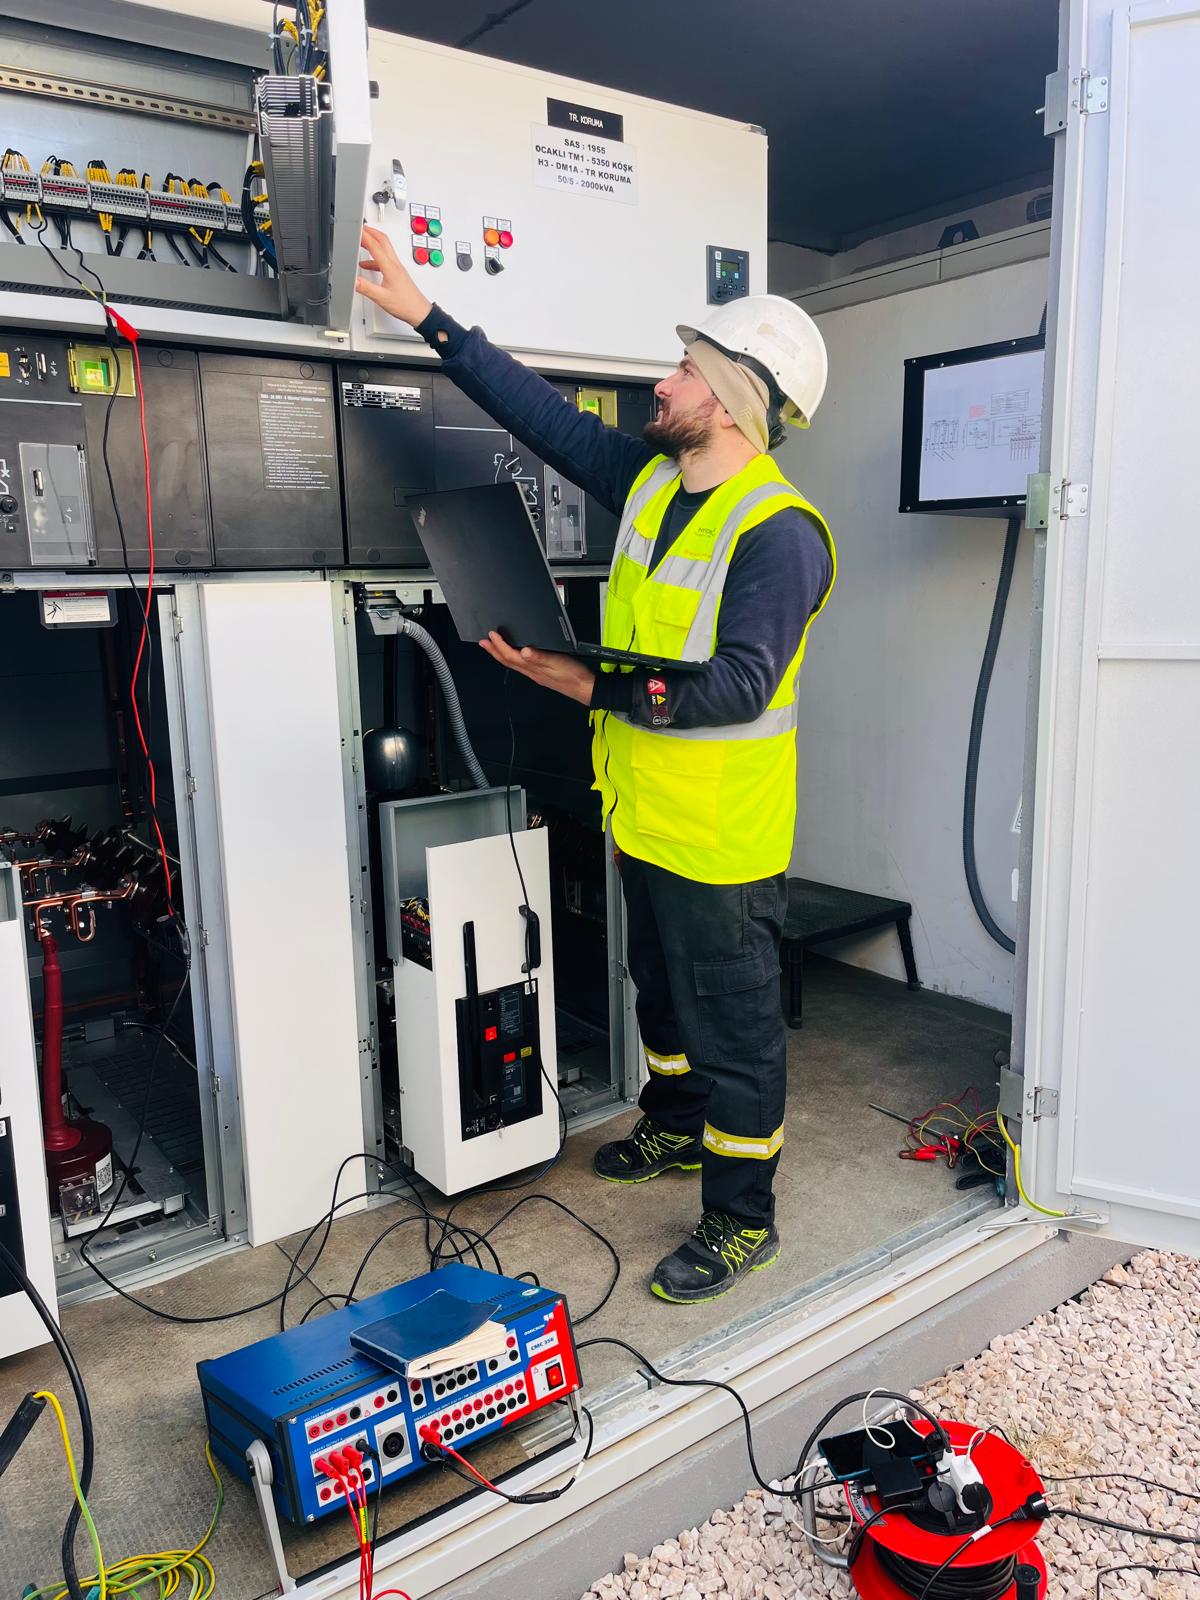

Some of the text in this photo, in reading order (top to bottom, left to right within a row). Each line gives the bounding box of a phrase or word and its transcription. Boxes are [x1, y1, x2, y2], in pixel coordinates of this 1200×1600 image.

[569, 113, 604, 128] TR. KORUMA
[564, 138, 580, 149] SAS
[587, 144, 606, 154] 1955
[535, 145, 566, 158] OCAKLI
[568, 152, 585, 162] TM1
[591, 157, 610, 168] 5350
[538, 158, 549, 167] H3
[556, 162, 579, 173] DM1A
[585, 168, 596, 177] TR
[598, 171, 632, 184] KORUMA
[557, 175, 574, 185] 50/5
[580, 180, 614, 193] 2000kVA
[524, 1323, 545, 1336] OMICRON
[530, 1342, 544, 1351] CMC
